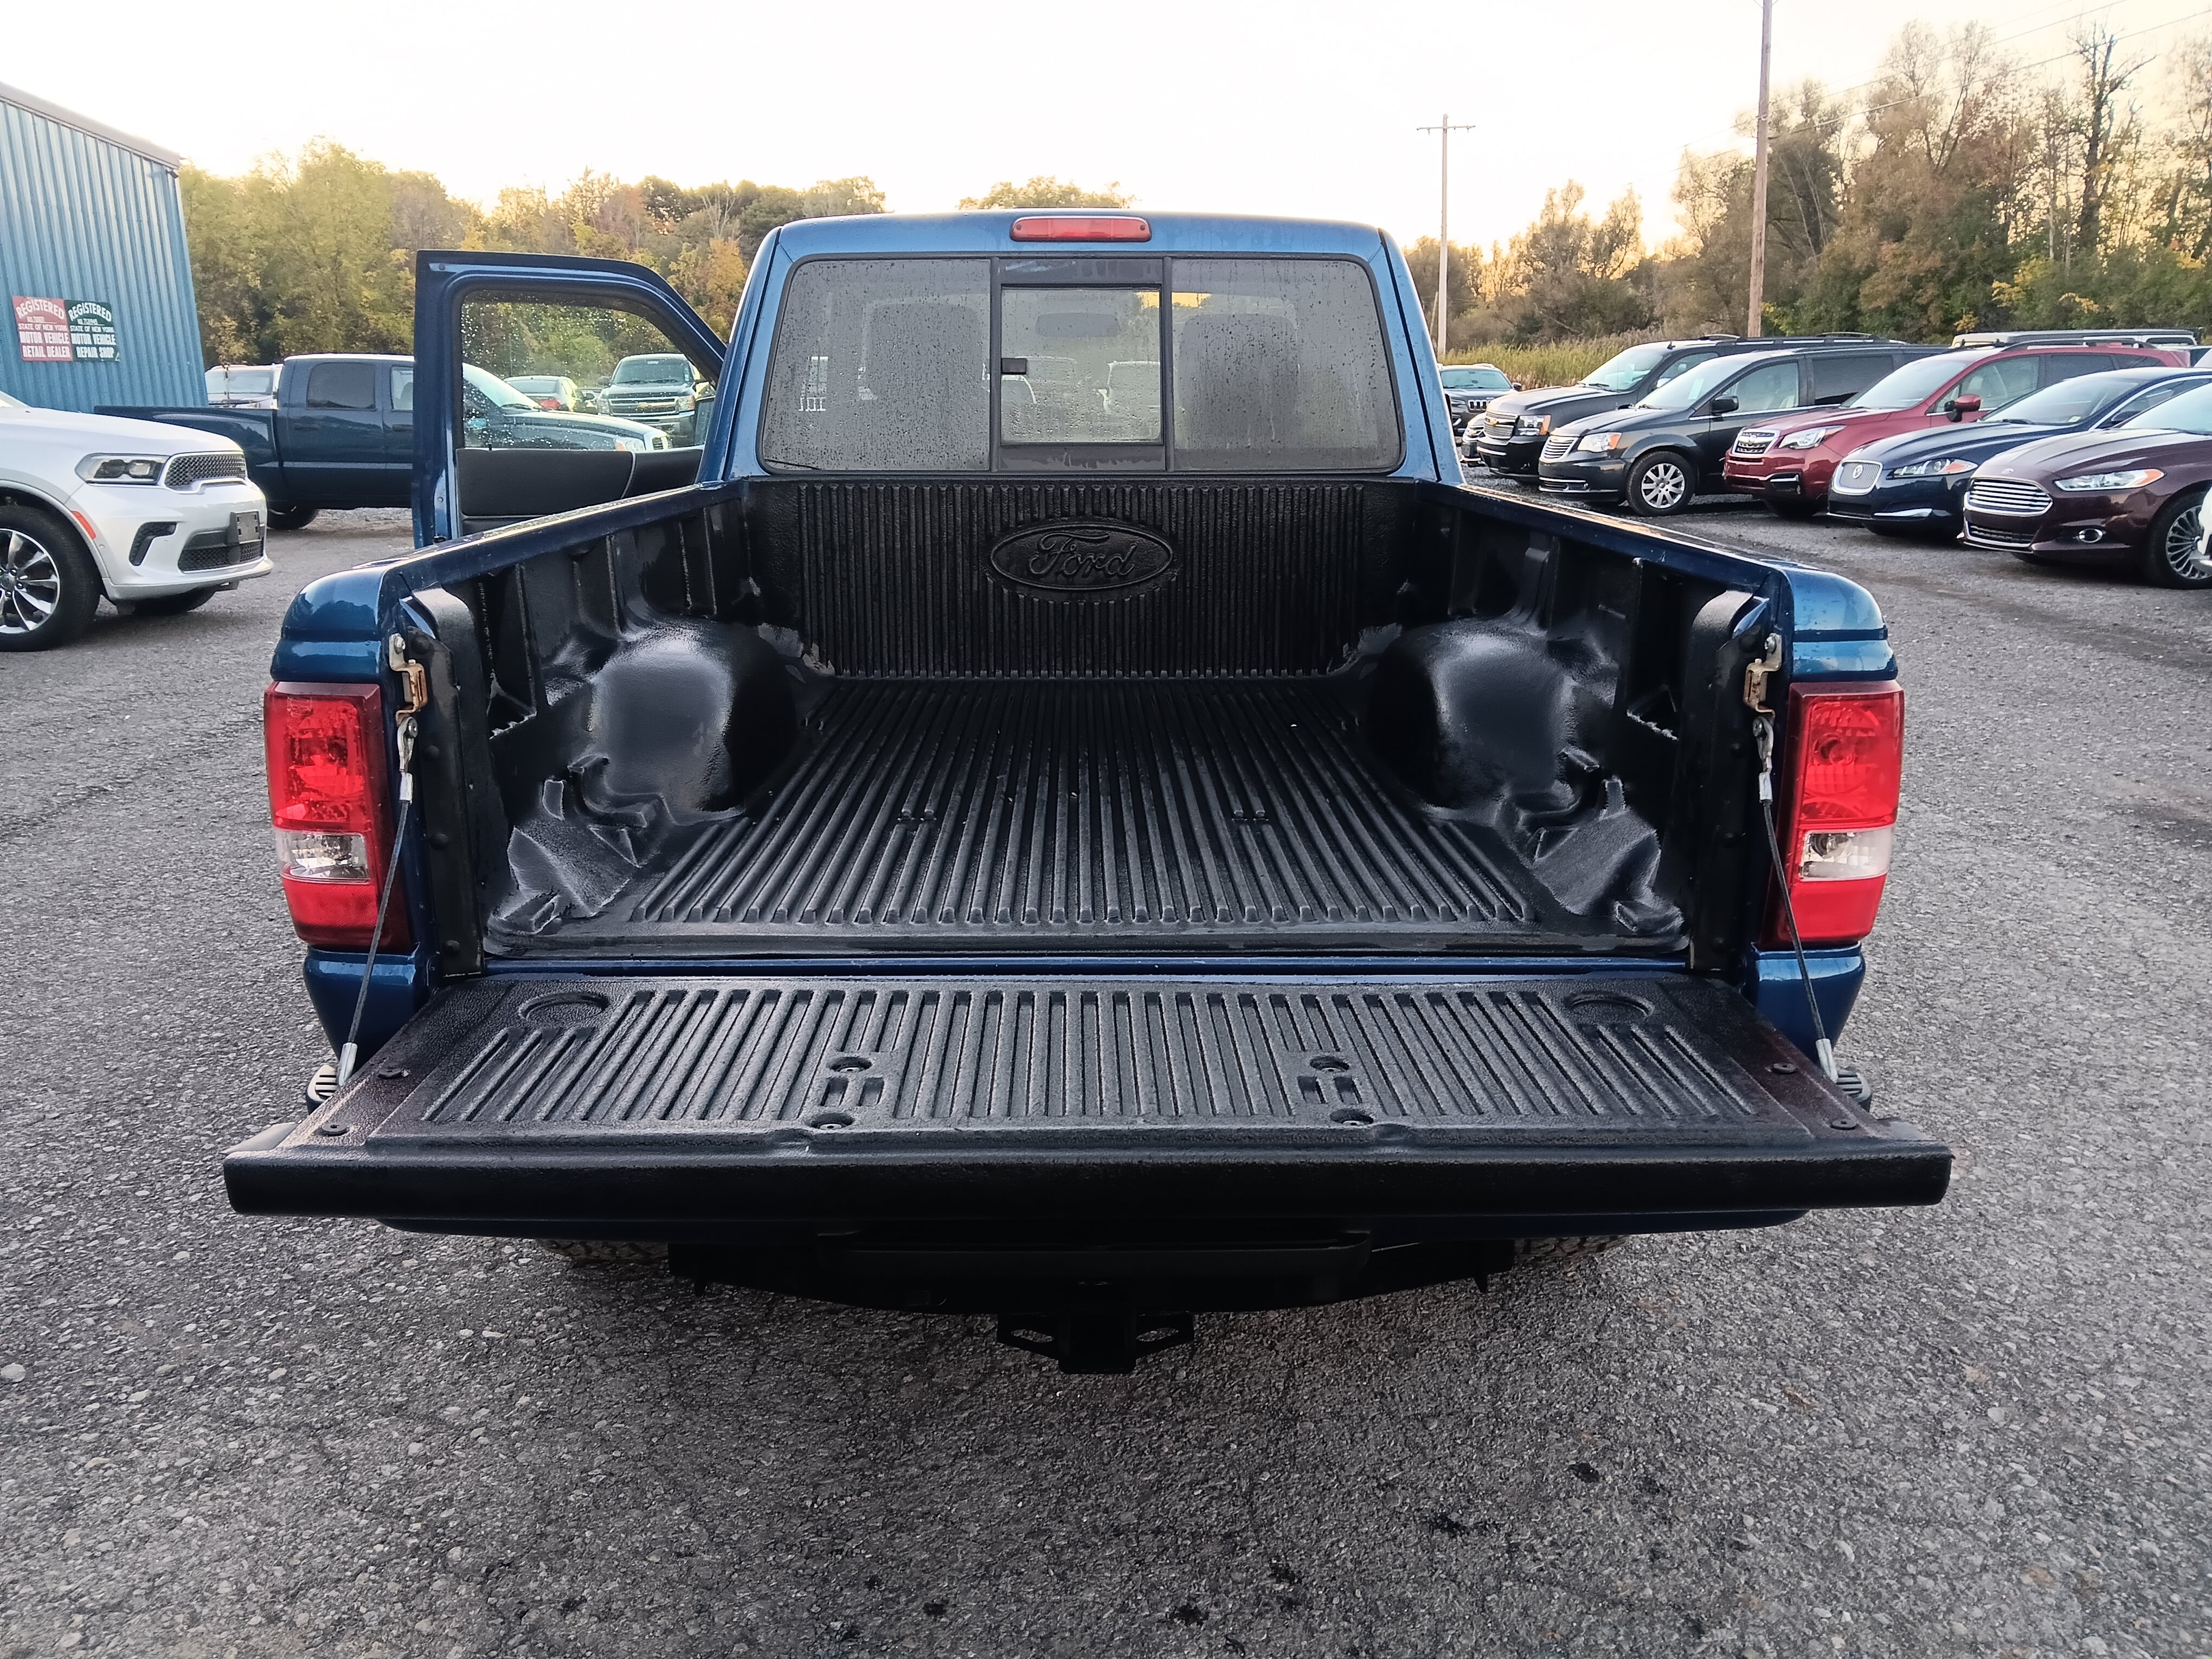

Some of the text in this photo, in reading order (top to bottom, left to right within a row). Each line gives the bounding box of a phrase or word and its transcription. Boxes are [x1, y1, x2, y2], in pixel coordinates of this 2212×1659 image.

[16, 299, 65, 320] REGISTERED
[68, 302, 112, 322] REGISTERED
[19, 331, 70, 344] MOTOR VEHICLE
[70, 333, 117, 345] MOTOR VEHICLE
[22, 345, 71, 358] RETAIL DEALER
[76, 346, 114, 358] REPAIR SHOP
[1030, 531, 1137, 577] Ford
